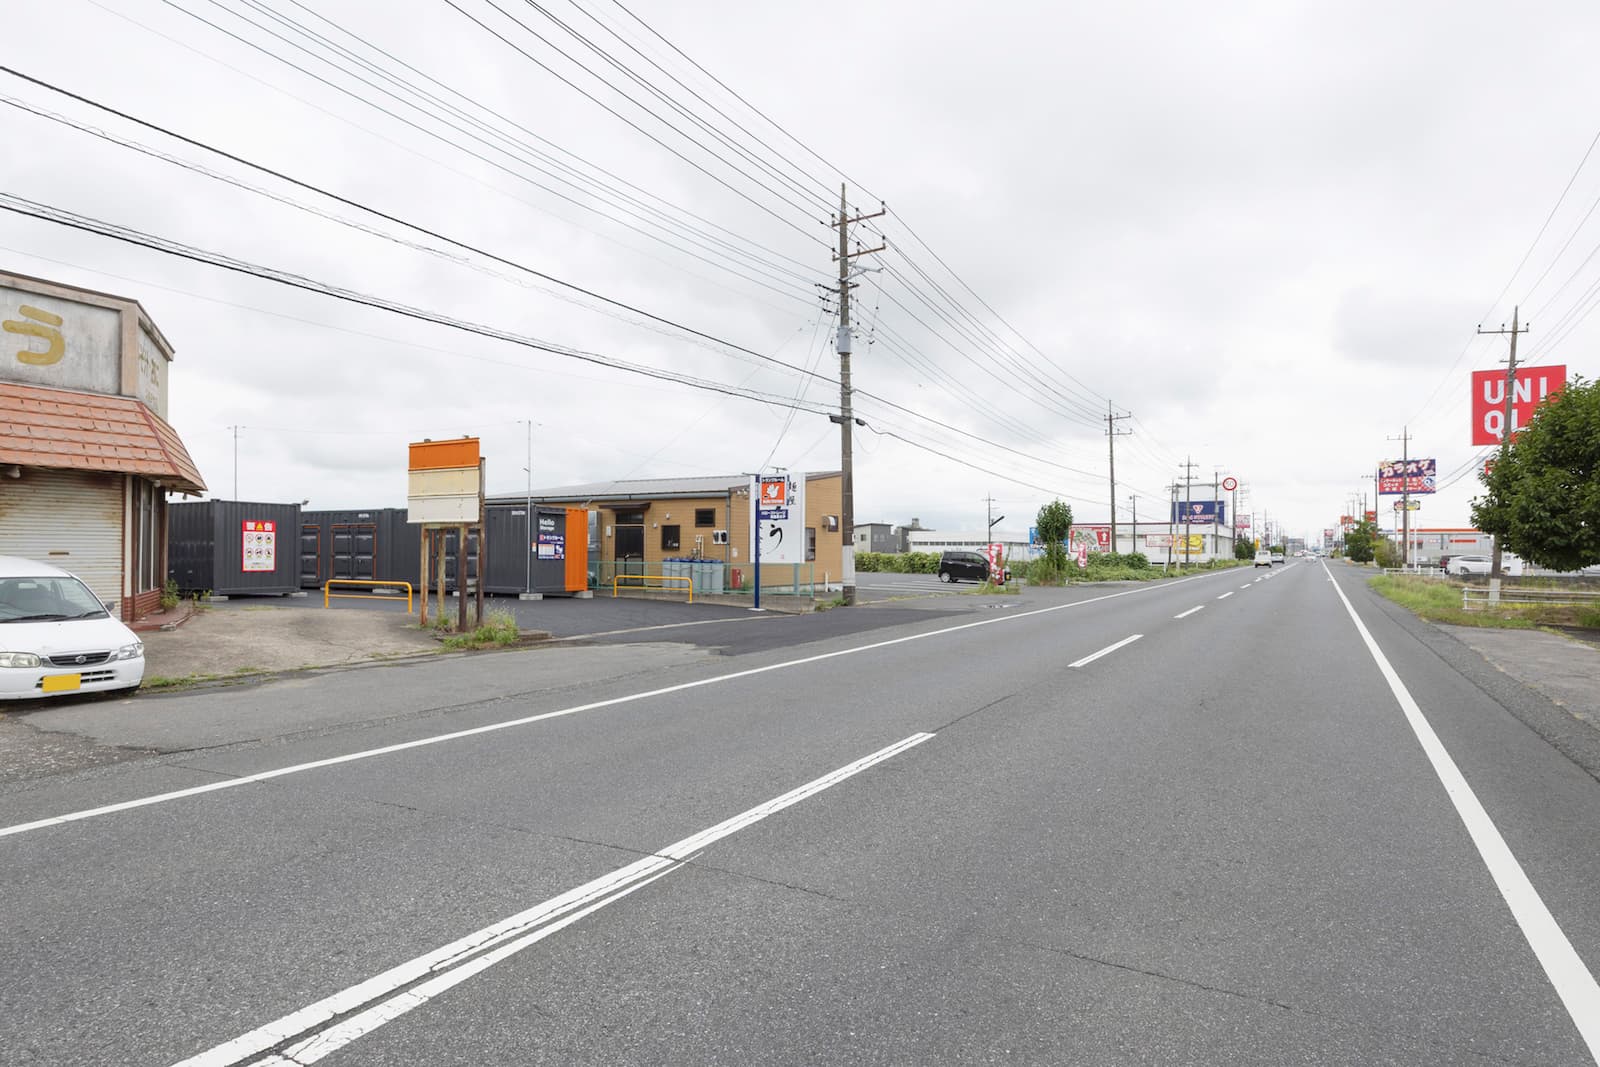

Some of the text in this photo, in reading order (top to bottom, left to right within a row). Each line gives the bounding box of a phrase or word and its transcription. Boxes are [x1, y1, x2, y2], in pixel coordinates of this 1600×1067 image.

[1483, 376, 1548, 405] UNI
[1381, 460, 1431, 478] カラオケ
[539, 518, 555, 526] Hello
[766, 523, 784, 554] う
